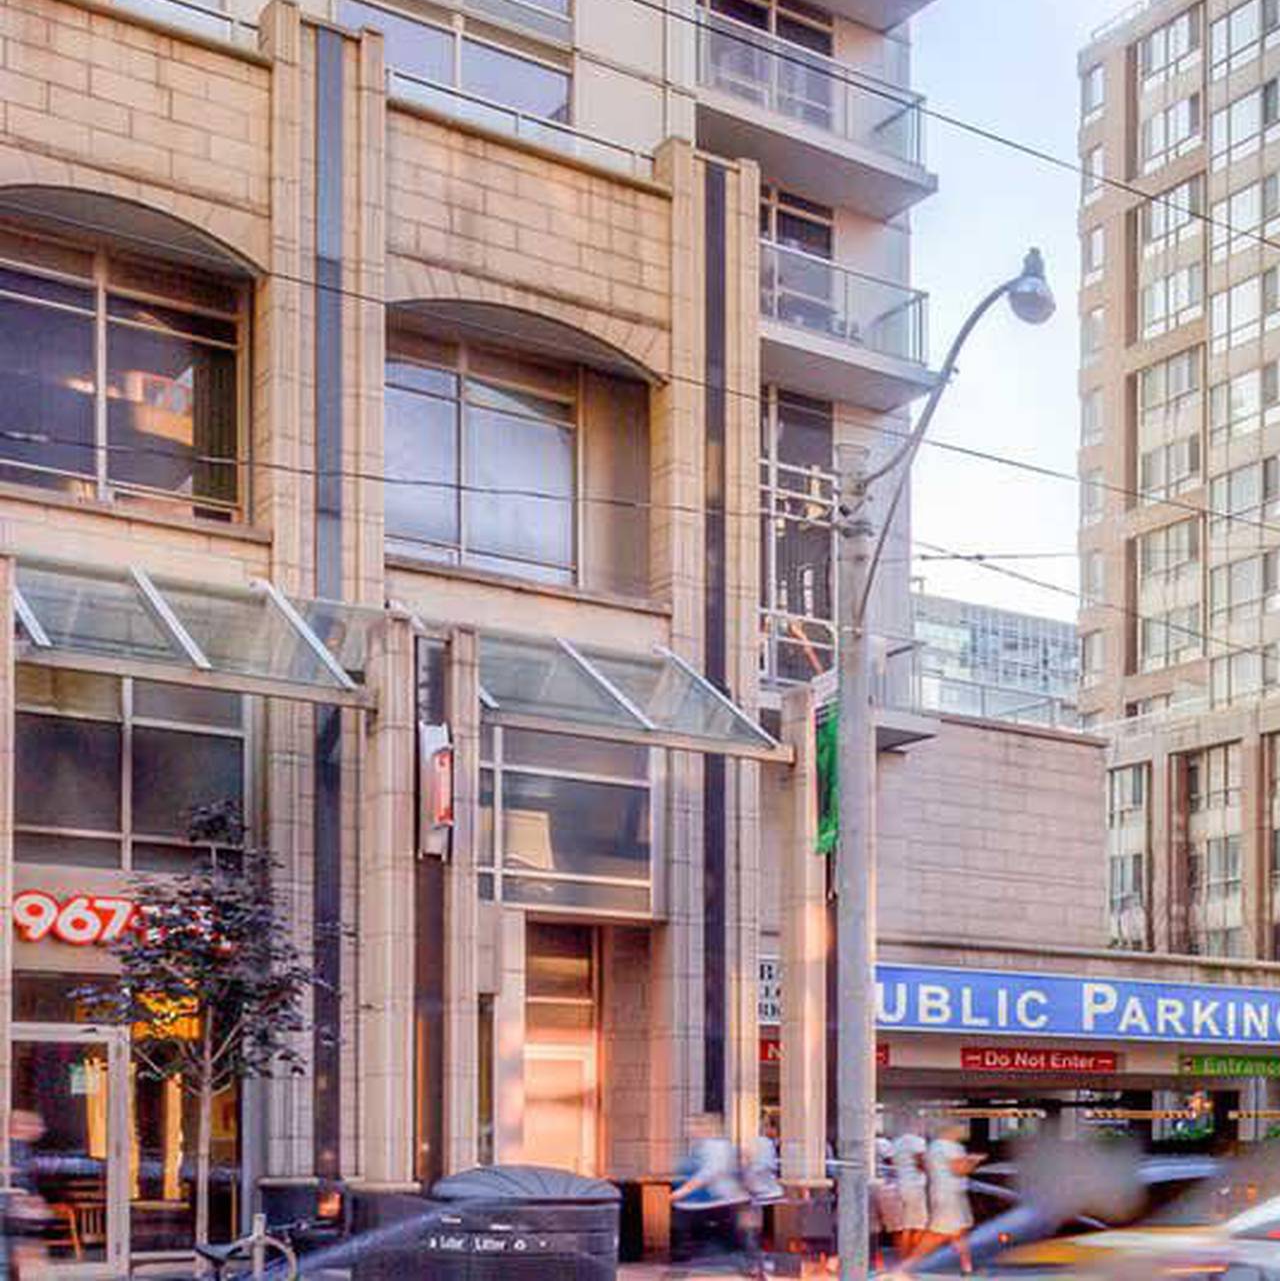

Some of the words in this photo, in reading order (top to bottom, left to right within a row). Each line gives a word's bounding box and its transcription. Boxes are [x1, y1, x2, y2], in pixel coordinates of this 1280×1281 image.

[872, 982, 1048, 1029] UBLIC
[985, 1051, 1010, 1066] Do
[1014, 1052, 1045, 1068] Not
[1051, 1053, 1095, 1069] Enter
